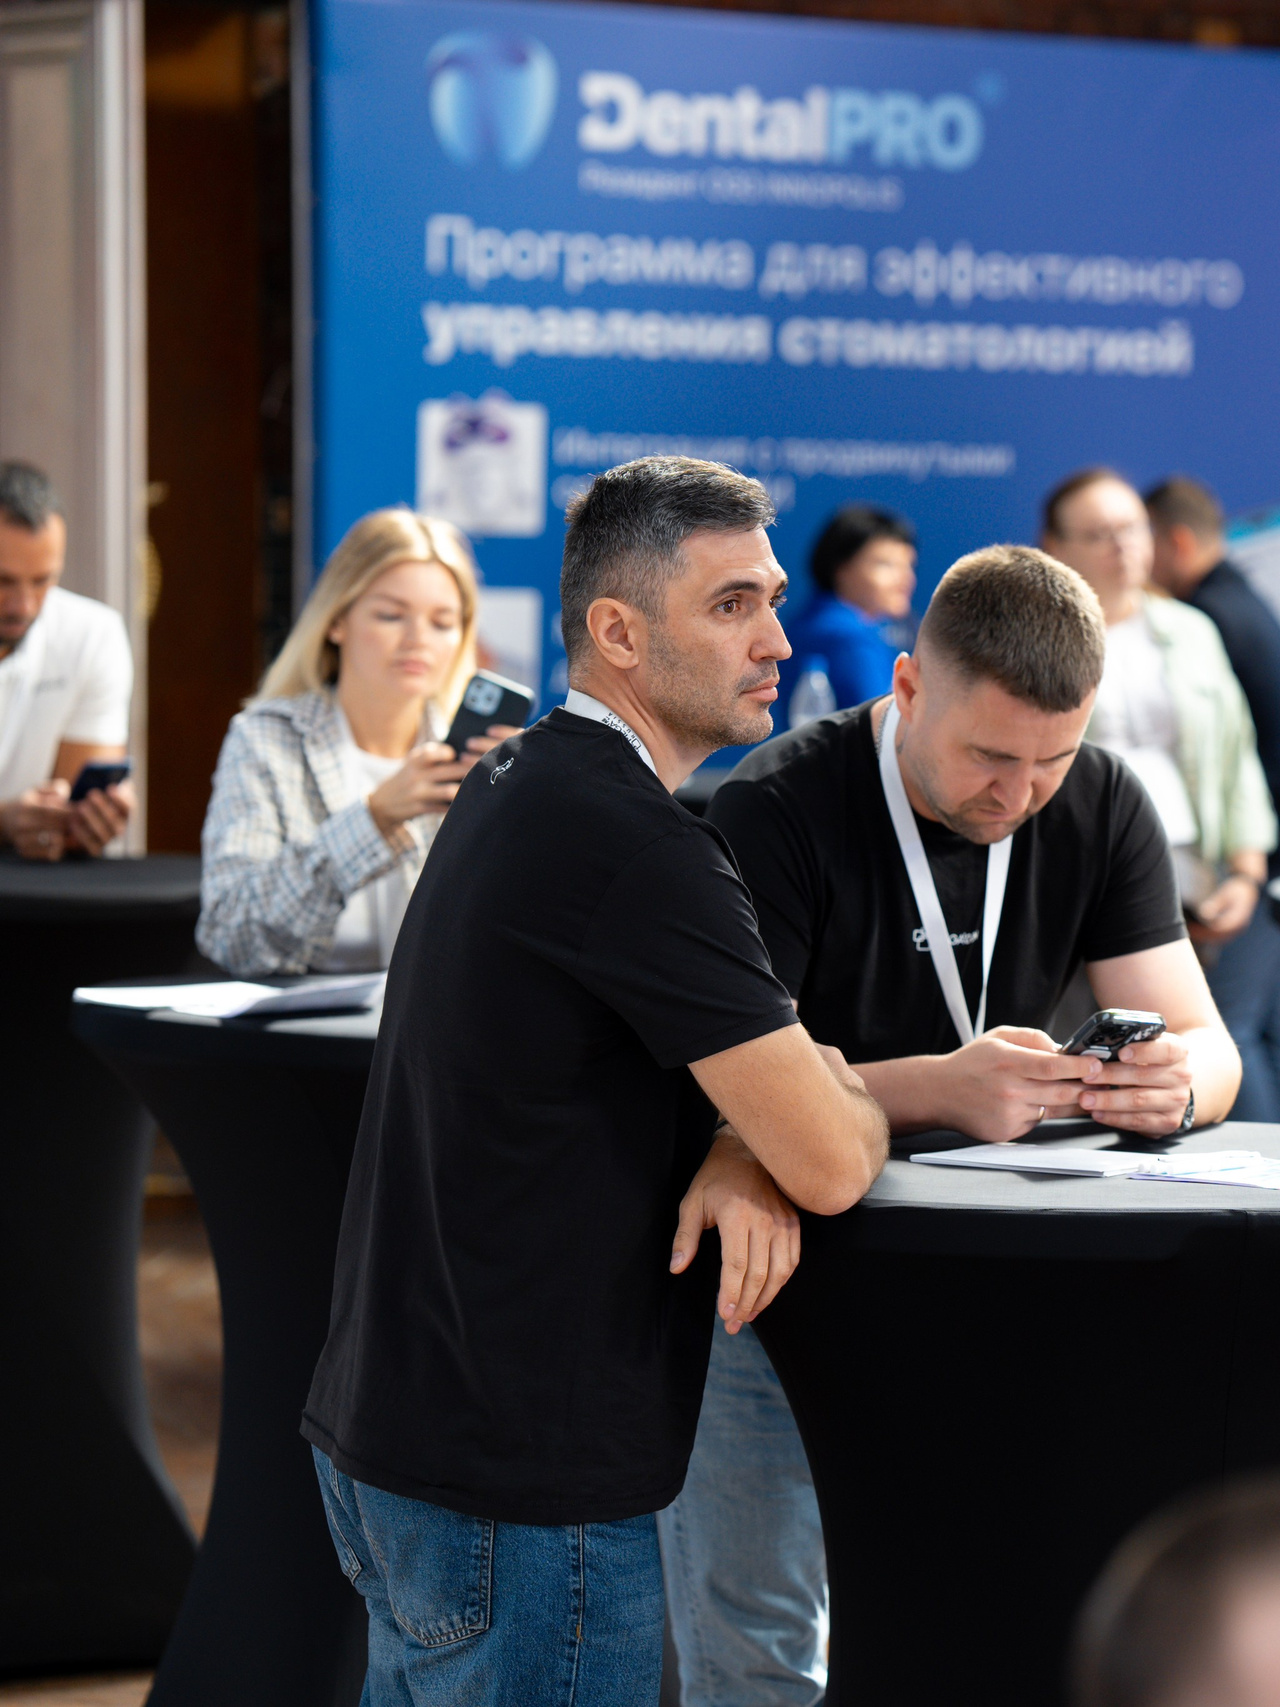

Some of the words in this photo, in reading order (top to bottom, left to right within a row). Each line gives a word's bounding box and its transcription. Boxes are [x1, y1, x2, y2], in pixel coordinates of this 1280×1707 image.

[580, 73, 983, 169] DentalPRO
[428, 216, 753, 290] Программа
[763, 239, 865, 294] для
[876, 239, 1241, 305] эффективного
[425, 303, 769, 364] управления
[780, 316, 1192, 374] стоматологией
